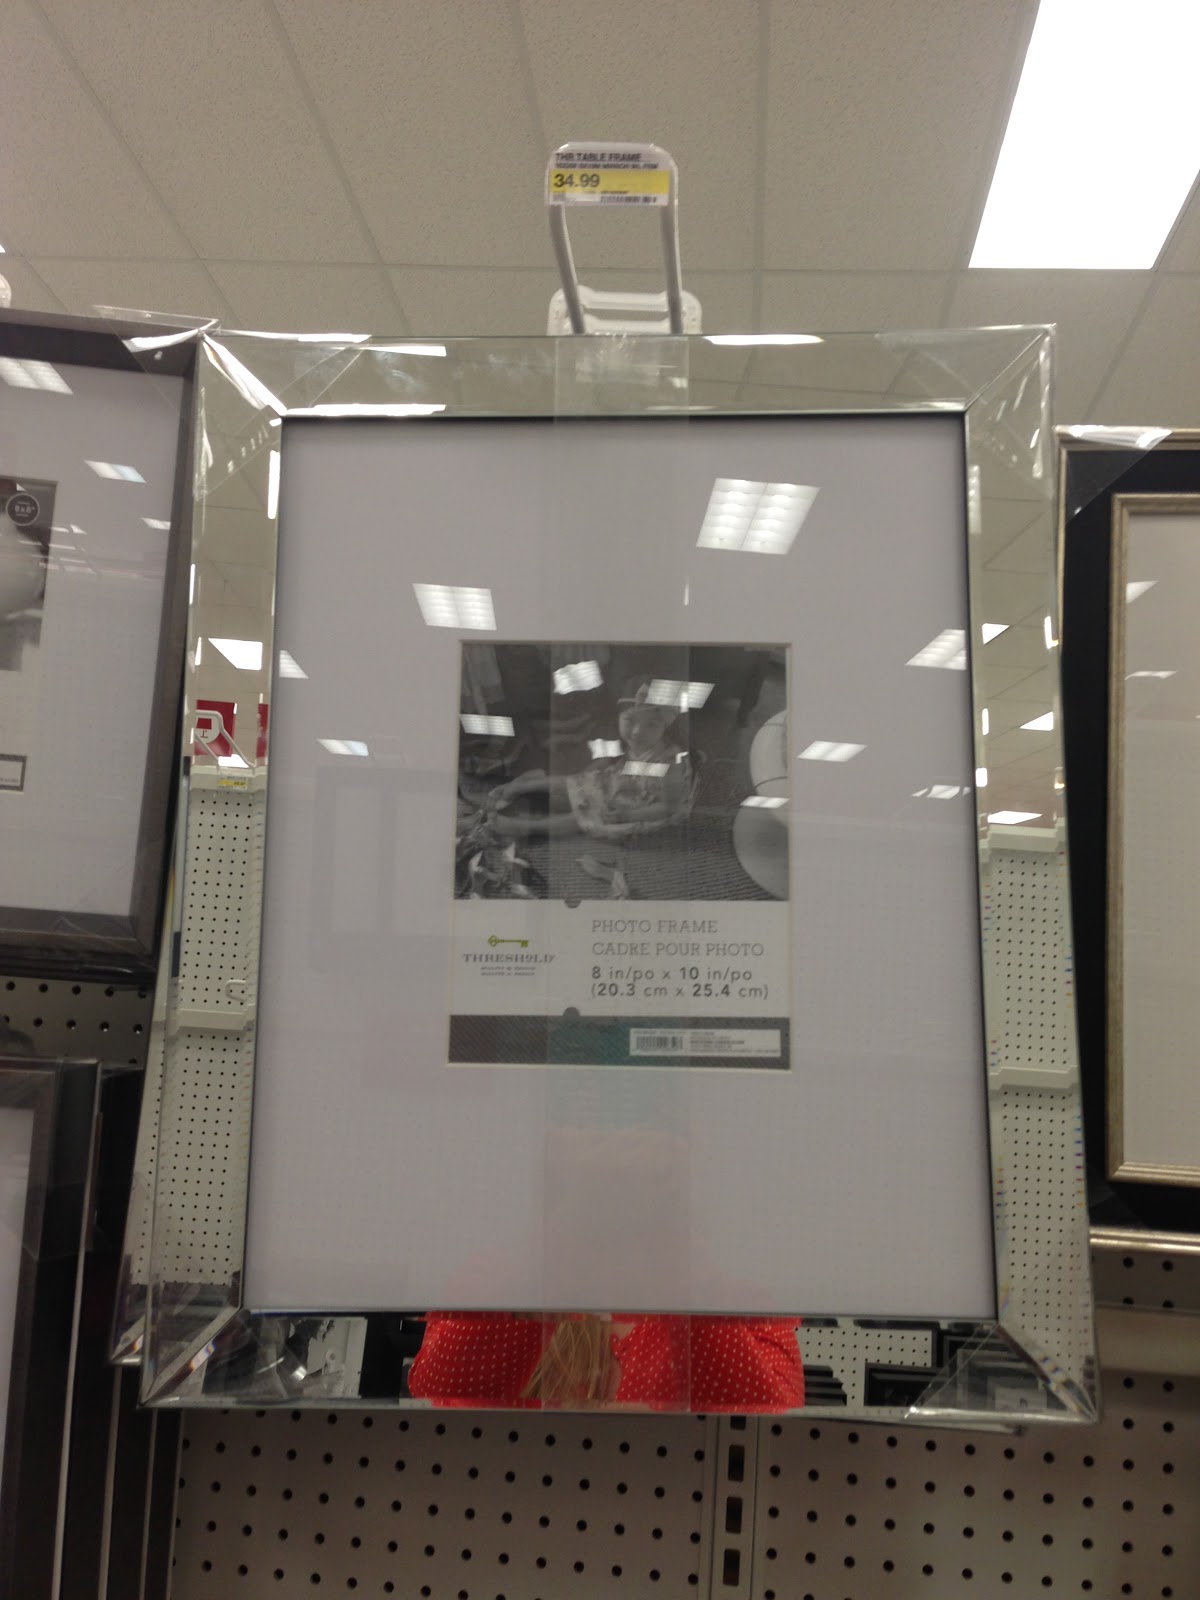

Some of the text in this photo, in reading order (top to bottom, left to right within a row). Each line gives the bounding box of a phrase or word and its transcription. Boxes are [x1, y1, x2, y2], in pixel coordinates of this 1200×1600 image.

[577, 152, 605, 161] TABLE
[609, 152, 642, 161] FRAME
[554, 173, 600, 188] 34.99
[591, 919, 718, 933] PHOTO FRAME
[591, 942, 765, 956] CADRE POUR PHOTO
[591, 966, 753, 984] 8 in/po x 10 in/po
[590, 983, 769, 1000] (20.3 cm x 25.4 cm)
